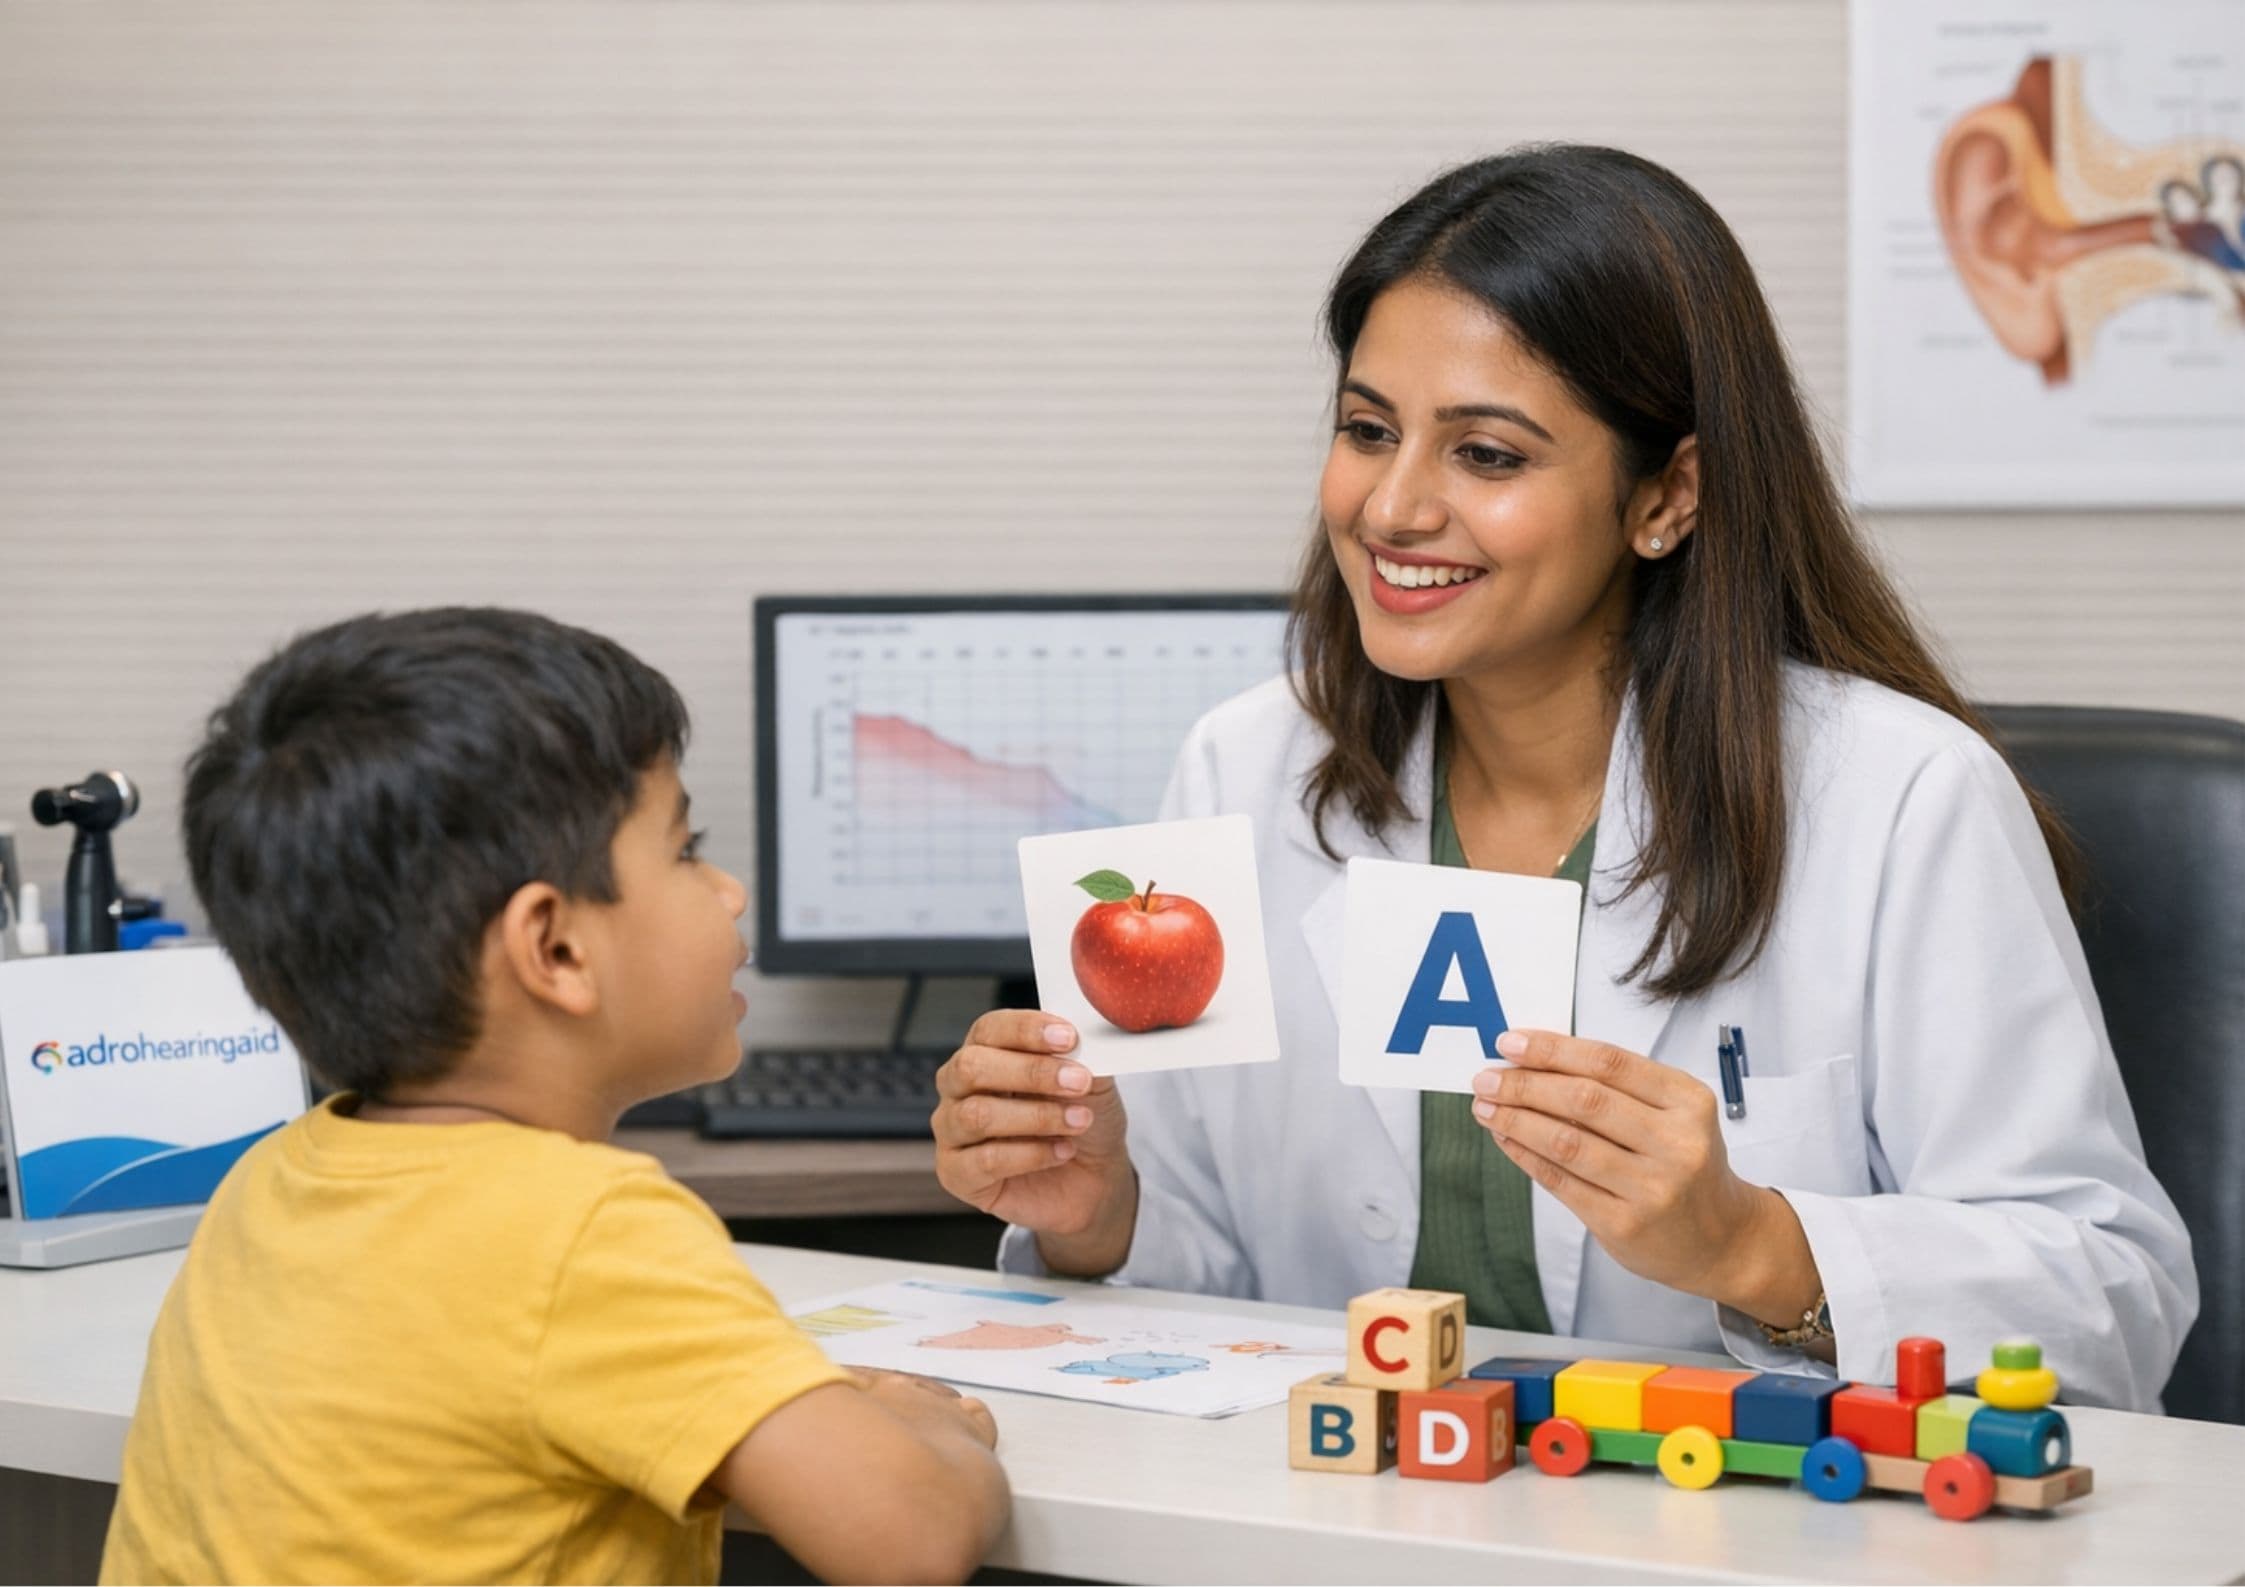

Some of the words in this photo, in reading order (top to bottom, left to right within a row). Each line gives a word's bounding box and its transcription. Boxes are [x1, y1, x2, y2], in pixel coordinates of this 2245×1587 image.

[1385, 911, 1509, 1059] A
[67, 1025, 280, 1067] adrohearingaid
[1362, 1316, 1409, 1373] C
[1439, 1313, 1457, 1369] D
[1310, 1403, 1355, 1457] B
[1419, 1410, 1469, 1465] D
